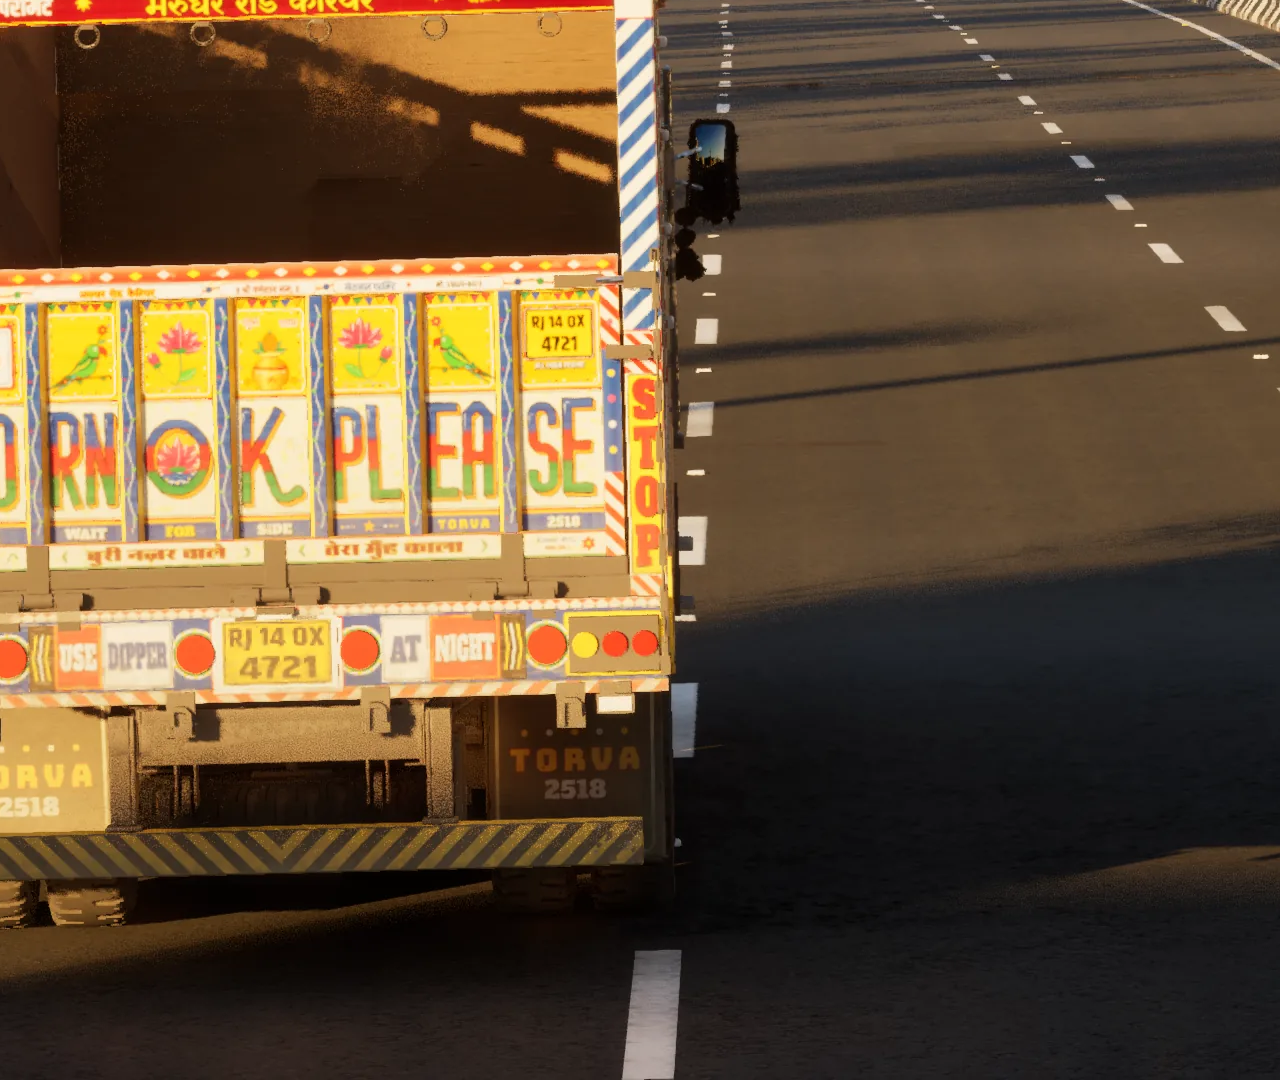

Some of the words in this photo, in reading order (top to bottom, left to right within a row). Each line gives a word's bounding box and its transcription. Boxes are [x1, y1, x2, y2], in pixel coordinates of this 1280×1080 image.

[531, 316, 544, 330] RJ
[549, 316, 562, 327] 14
[542, 336, 577, 351] 4721
[632, 377, 660, 568] STOP
[64, 527, 108, 540] WAIT
[165, 525, 196, 537] FOR
[256, 523, 293, 535] SIDE
[229, 629, 252, 651] RJ
[260, 628, 285, 646] 14
[59, 643, 98, 672] USE
[107, 641, 168, 671] DIPPER
[389, 635, 421, 663] AT
[434, 632, 496, 663] NIGHT
[239, 656, 317, 680] 4721
[508, 746, 640, 773] TORVA
[544, 778, 607, 799] 2518
